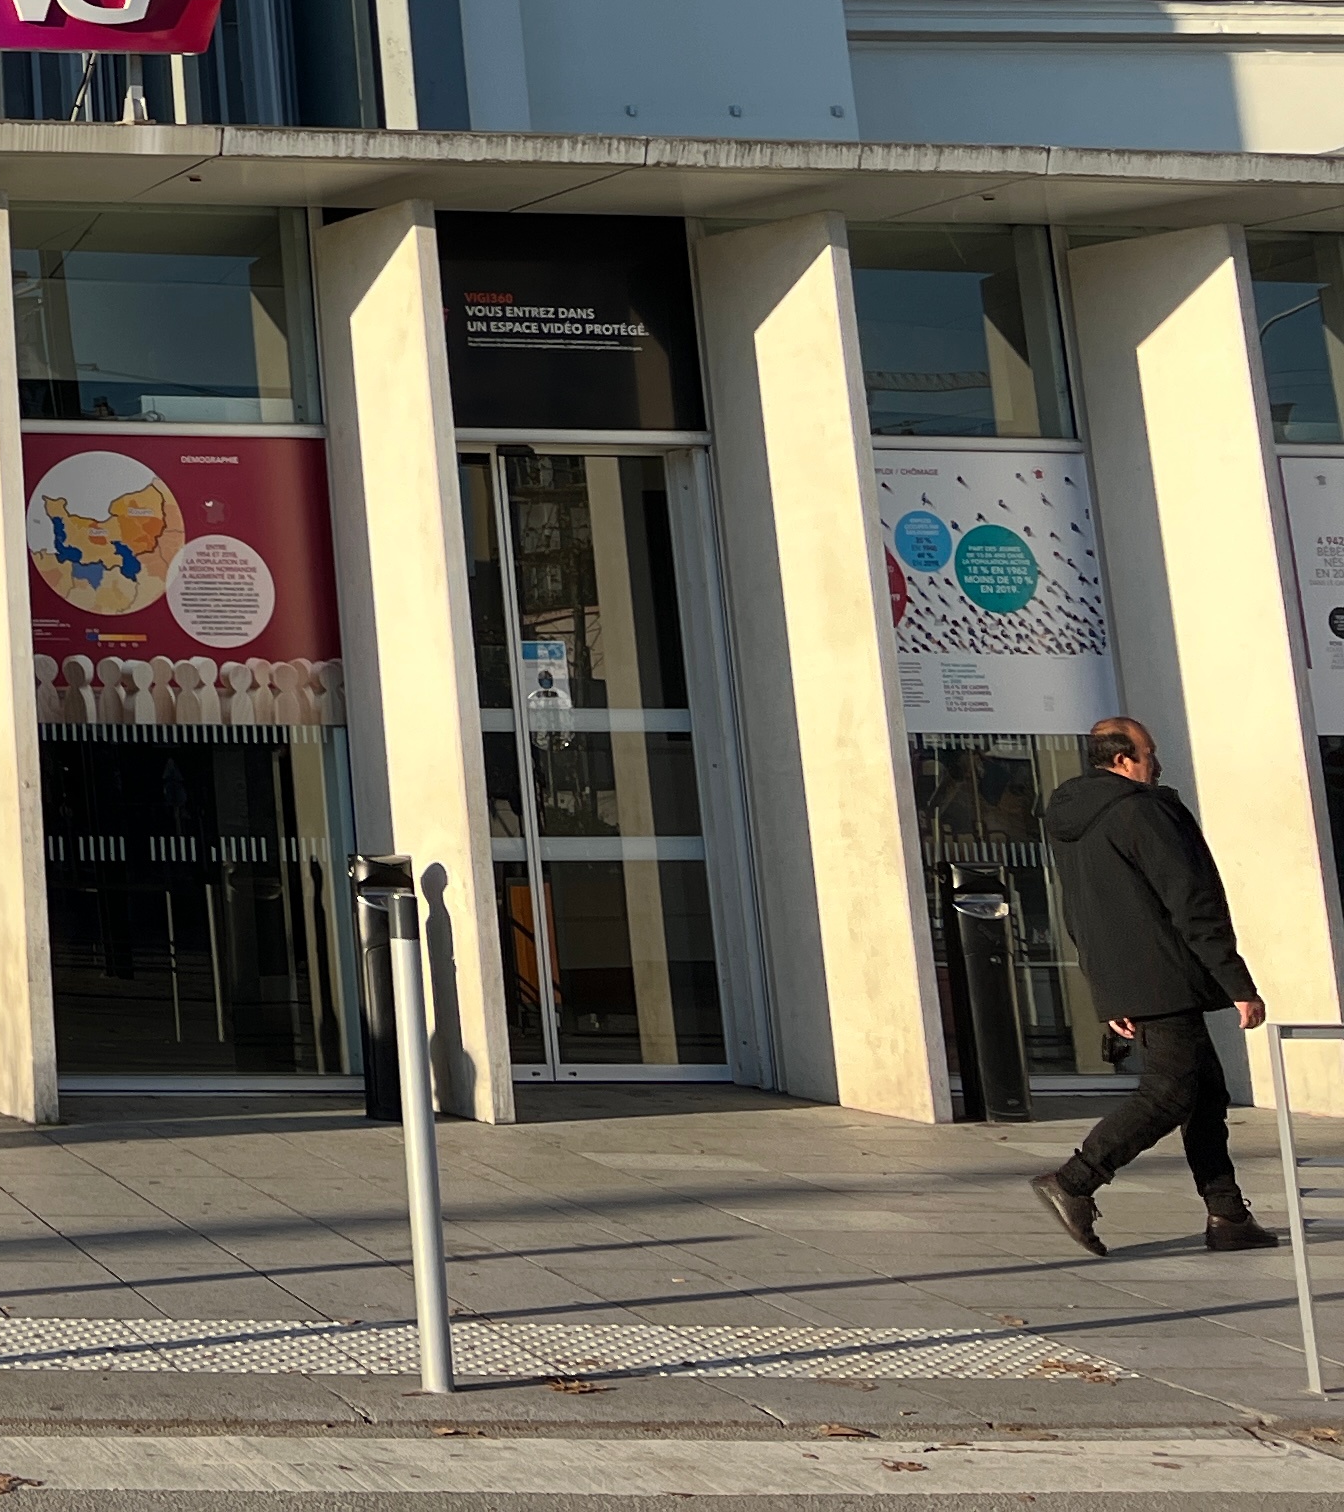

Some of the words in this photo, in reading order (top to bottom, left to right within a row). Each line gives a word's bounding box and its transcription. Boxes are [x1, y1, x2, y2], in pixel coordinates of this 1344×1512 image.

[464, 293, 513, 303] VIGI360
[465, 306, 503, 317] VOUS
[506, 306, 555, 318] ENTREZ
[558, 308, 595, 319] DANS
[467, 321, 487, 332] UN
[490, 322, 539, 334] ESPACE
[540, 321, 583, 335] VIDÉO
[586, 322, 650, 336] PROTÉGÉ.
[181, 455, 239, 464] DÉMOGRAPHIE
[981, 566, 989, 574] %
[1007, 567, 1028, 575] 1962
[964, 576, 995, 584] MOINS
[997, 576, 1009, 584] DE
[1012, 576, 1023, 584] 10
[980, 585, 994, 593] EN
